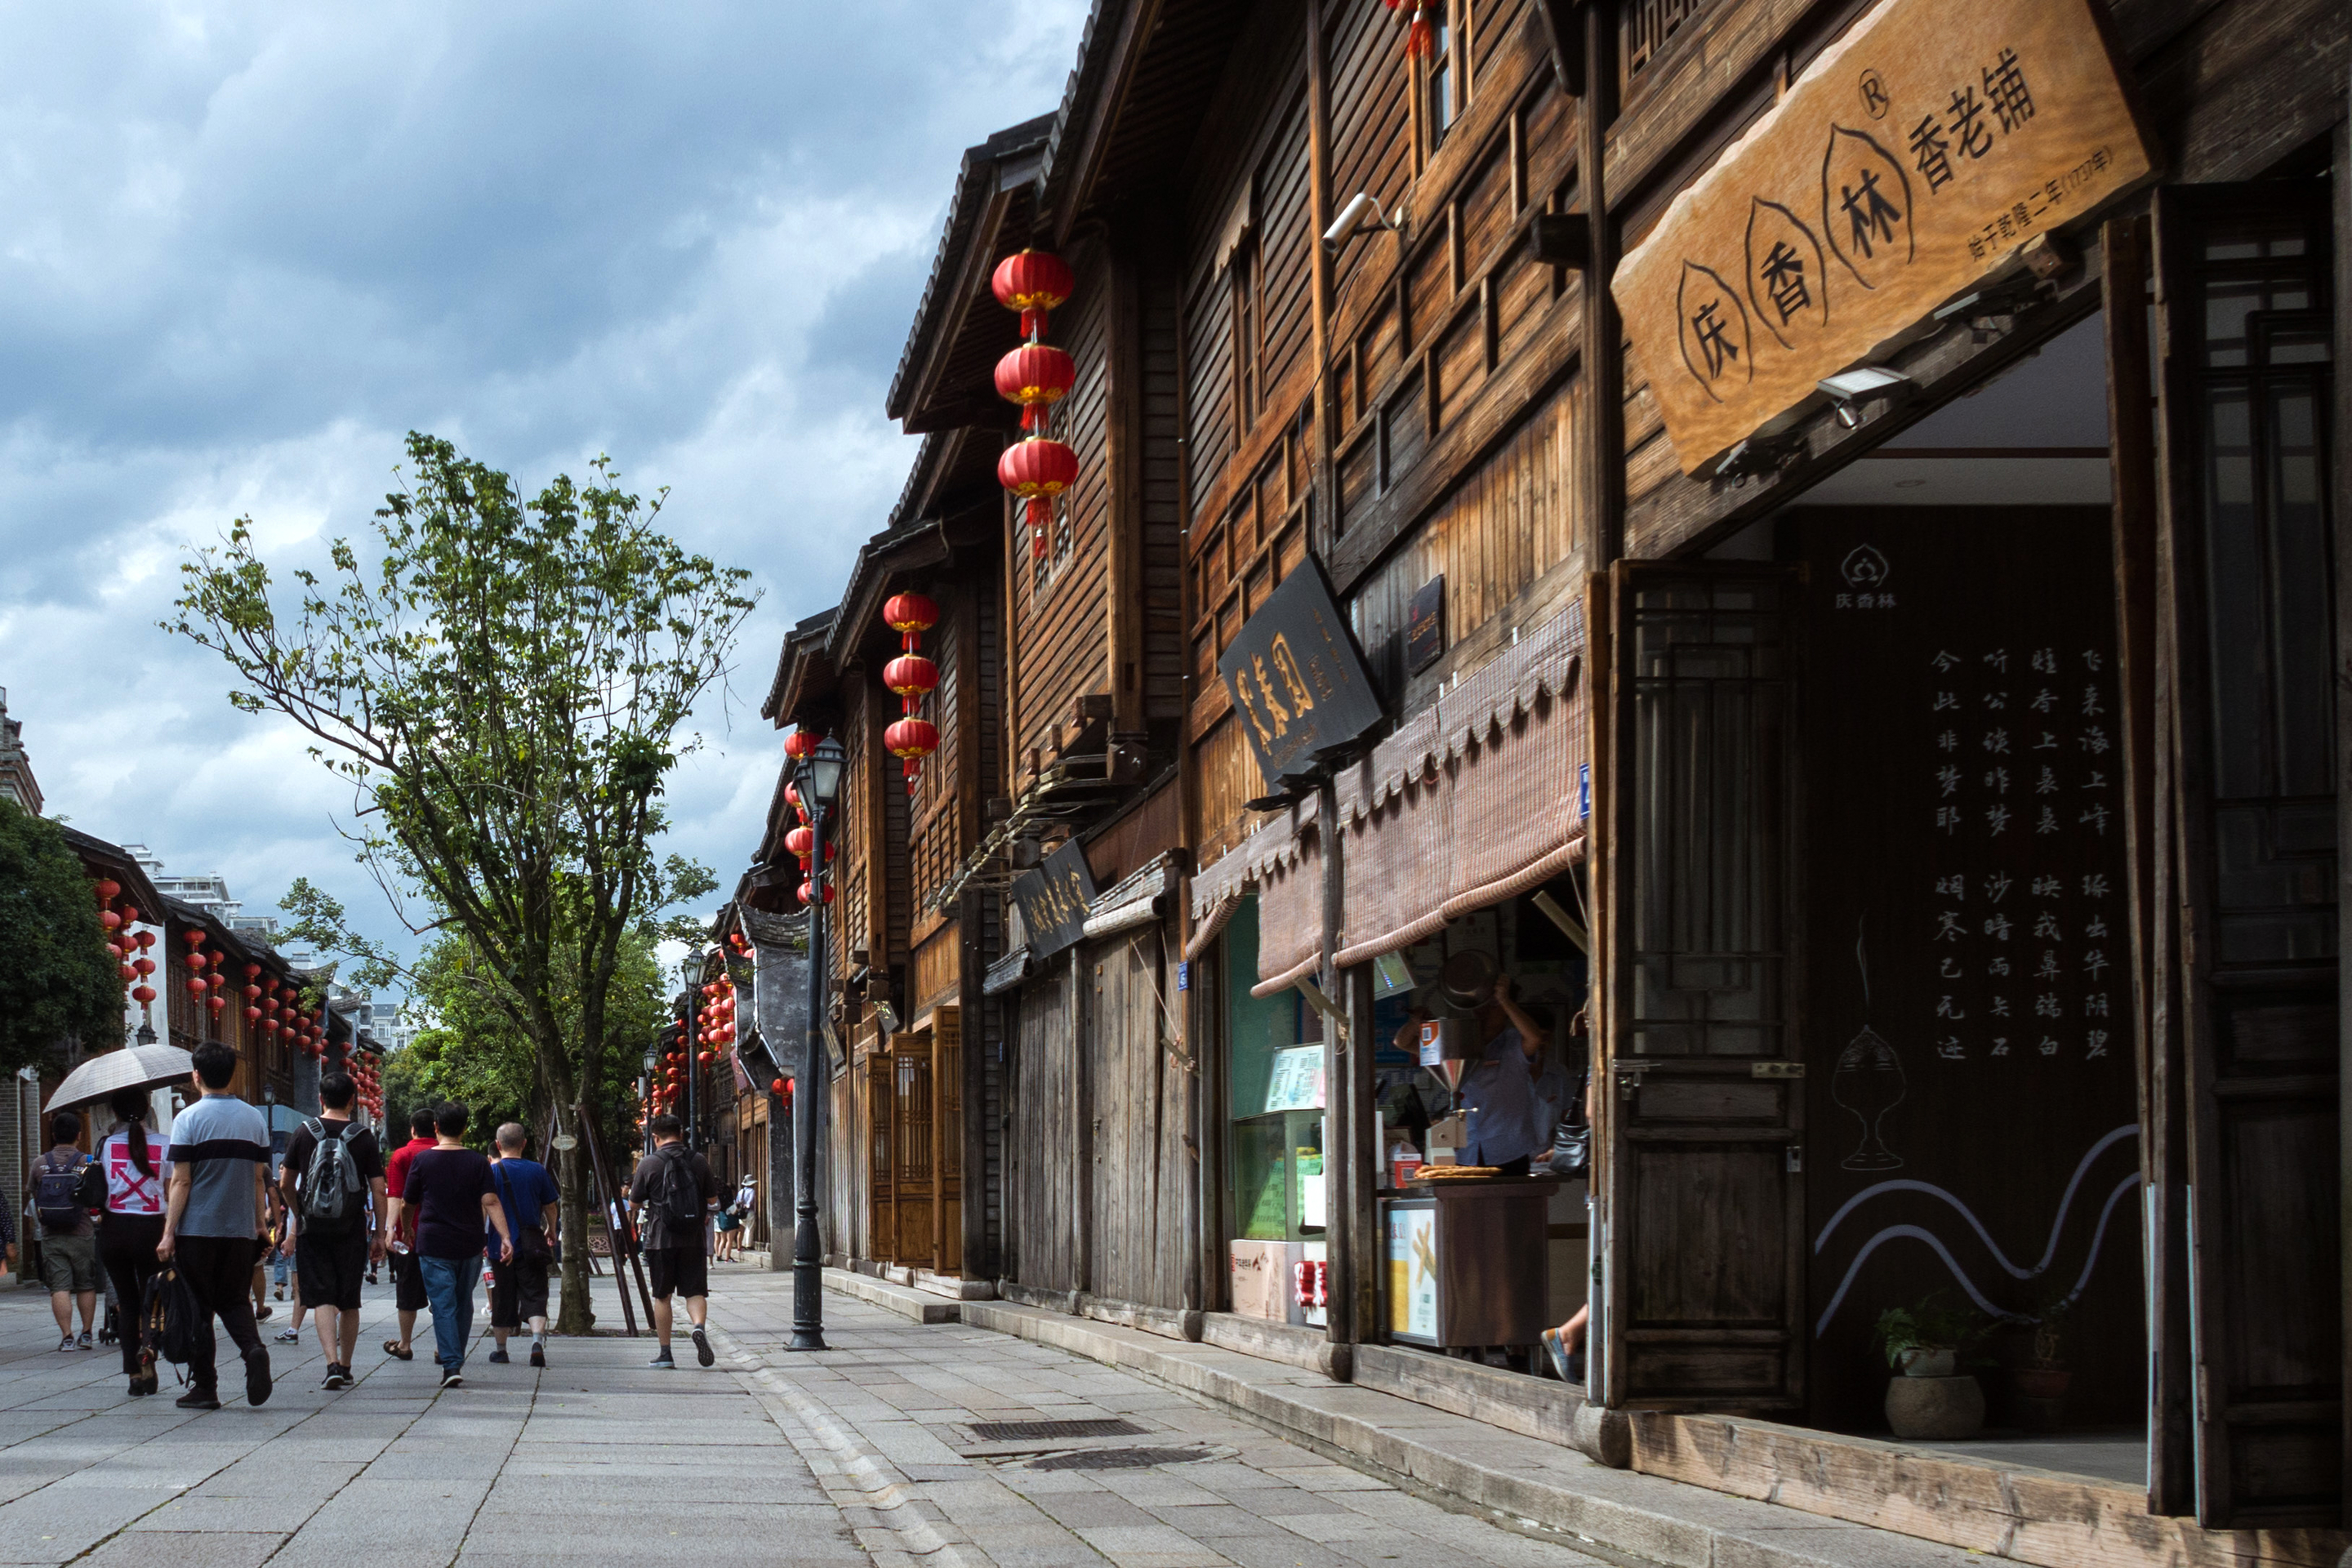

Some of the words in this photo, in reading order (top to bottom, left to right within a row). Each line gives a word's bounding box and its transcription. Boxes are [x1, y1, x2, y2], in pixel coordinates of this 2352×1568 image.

[1690, 168, 1901, 381] 庆香林
[1909, 47, 2036, 196] 香老铺
[1835, 593, 1896, 609] 庆香林
